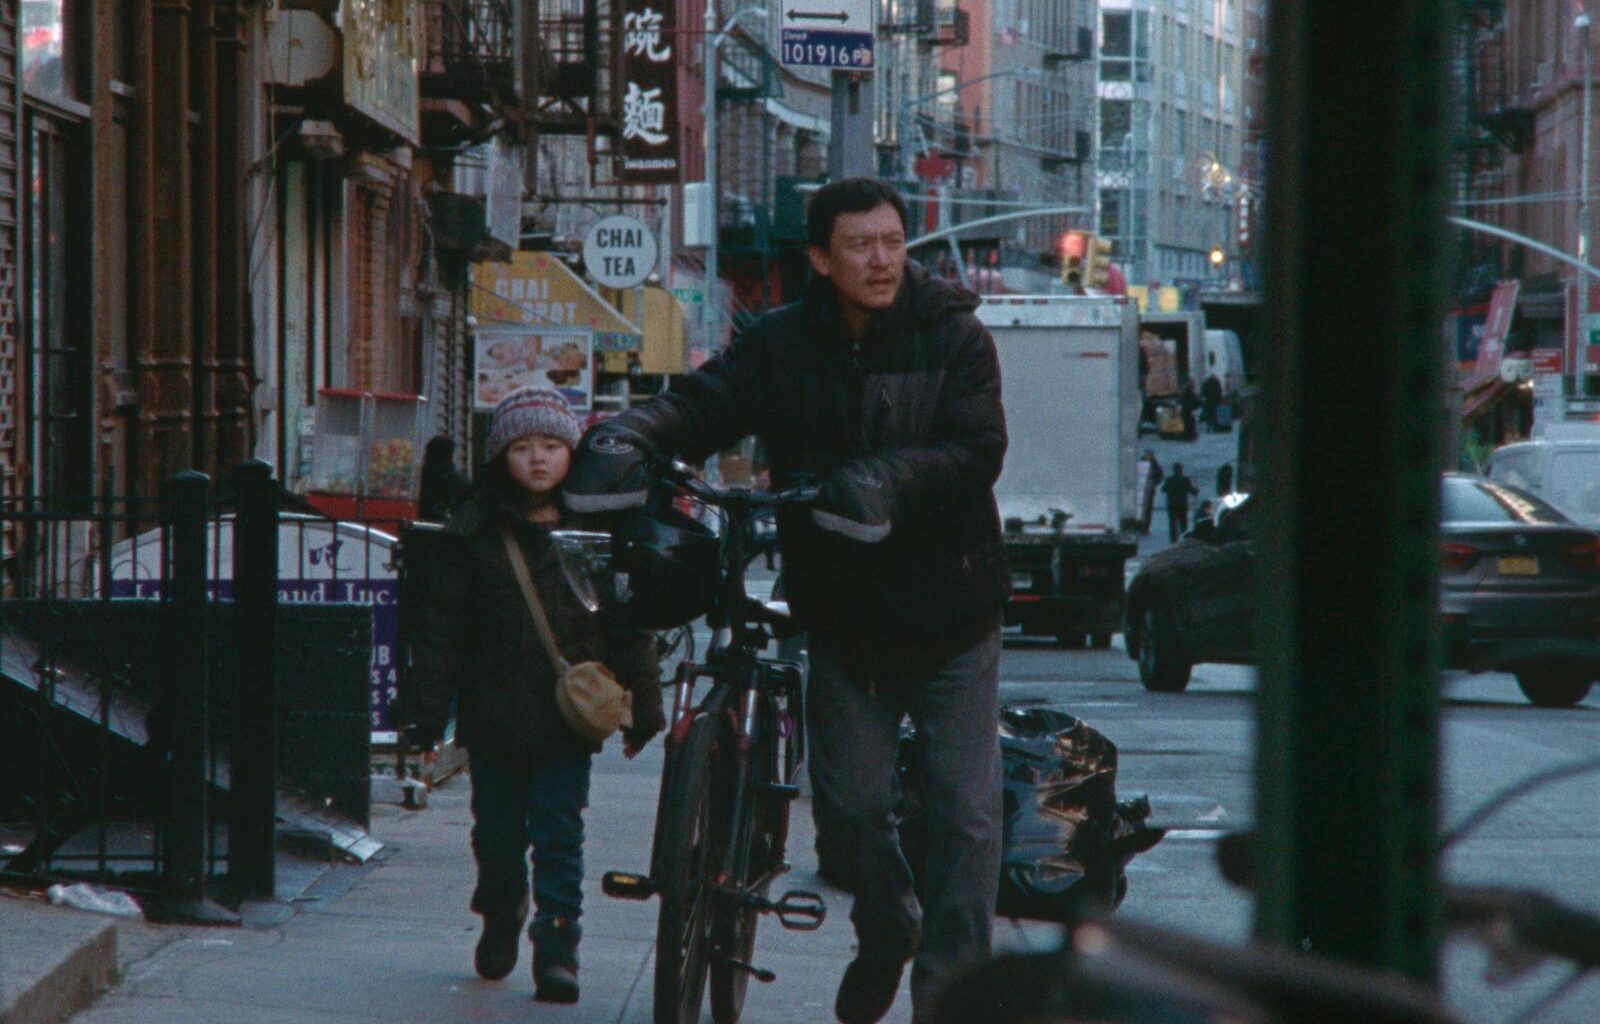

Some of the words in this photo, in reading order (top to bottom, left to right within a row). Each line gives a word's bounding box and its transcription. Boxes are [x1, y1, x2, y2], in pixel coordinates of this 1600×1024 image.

[784, 44, 849, 64] 101916
[596, 228, 642, 248] CHAI
[603, 257, 635, 276] TEA
[495, 278, 548, 302] CHAI
[522, 302, 577, 325] SPOT
